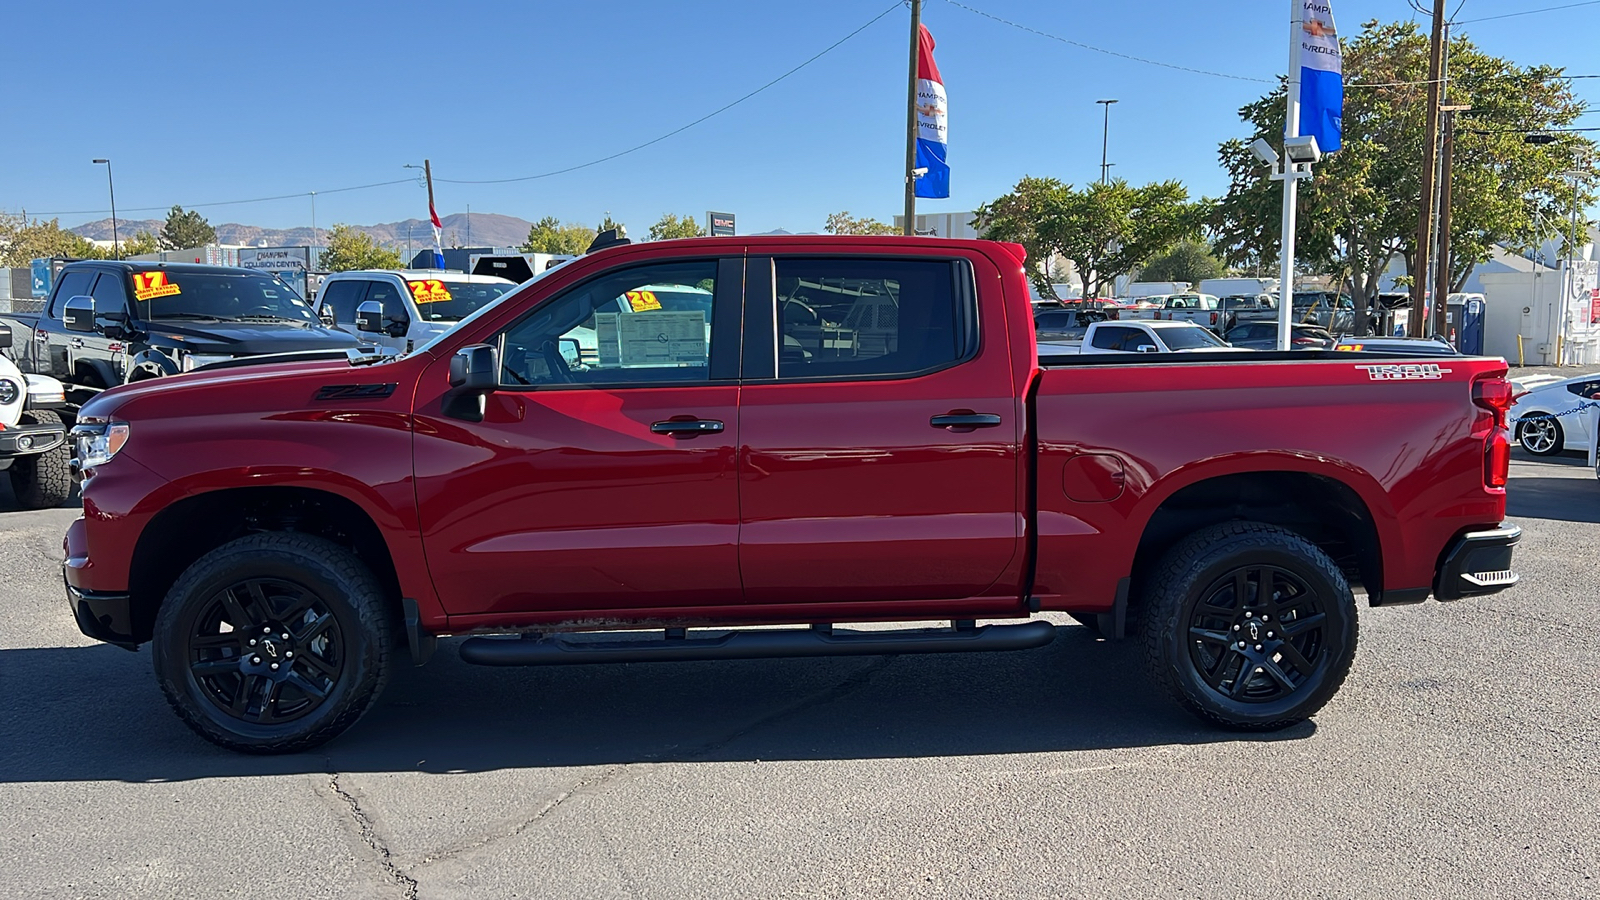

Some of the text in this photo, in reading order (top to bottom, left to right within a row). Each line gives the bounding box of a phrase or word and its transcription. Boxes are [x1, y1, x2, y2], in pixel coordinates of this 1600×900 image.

[1303, 2, 1331, 14] HAMPI
[1301, 42, 1339, 56] HEVROLE
[917, 120, 946, 131] EVROLET
[714, 218, 734, 227] GMC
[257, 250, 288, 260] CHAMPION
[244, 260, 301, 269] COLLISION CENTER
[134, 271, 163, 290] 17
[410, 280, 446, 295] 22
[628, 291, 655, 304] 20
